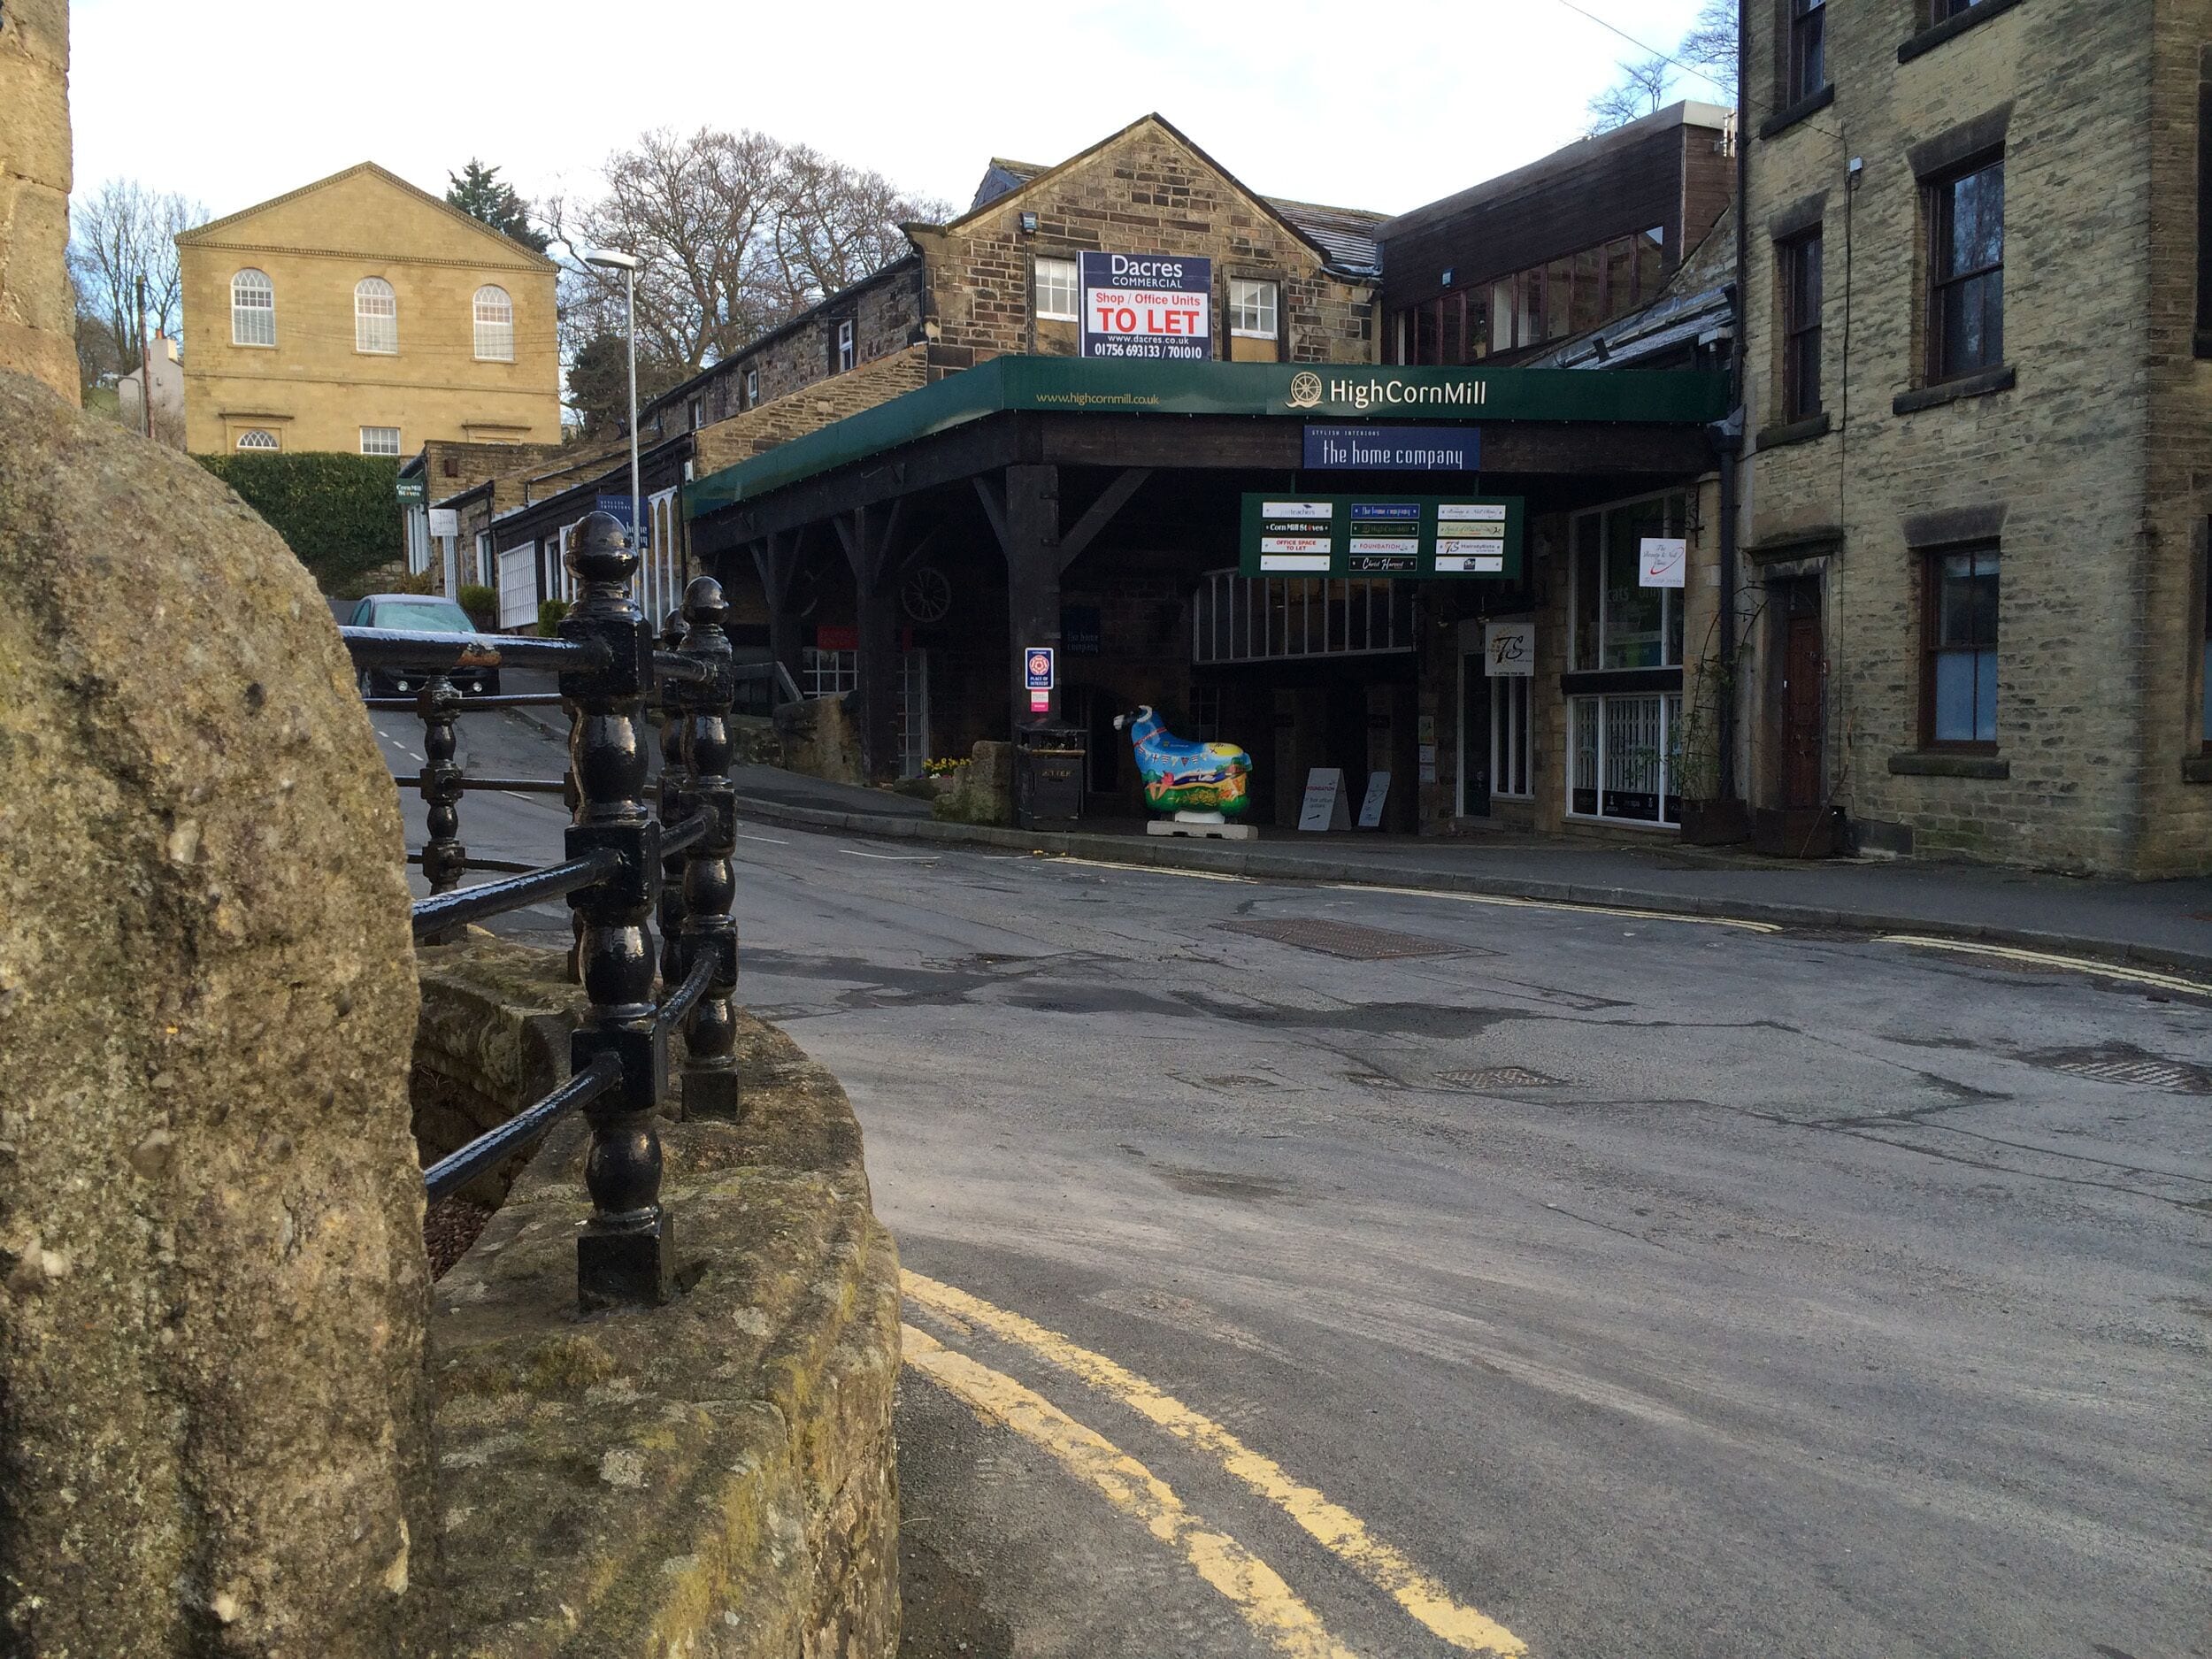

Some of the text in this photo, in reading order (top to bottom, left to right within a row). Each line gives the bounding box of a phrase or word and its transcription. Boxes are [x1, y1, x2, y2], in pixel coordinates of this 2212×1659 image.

[1111, 254, 1183, 278] Dacres
[1112, 276, 1183, 288] COMMERCIAL
[1095, 292, 1201, 306] Shop / Office Units
[1096, 307, 1200, 334] TO LET
[1107, 334, 1189, 345] www.dacres.co.uk
[1094, 342, 1202, 359] 01756 693133 / 701010
[1035, 391, 1160, 406] www.highcornmill.co.uk
[1330, 378, 1486, 409] HighCornMill
[1324, 439, 1463, 470] the home company
[1270, 523, 1286, 532] Corn
[1286, 523, 1299, 532] Mill
